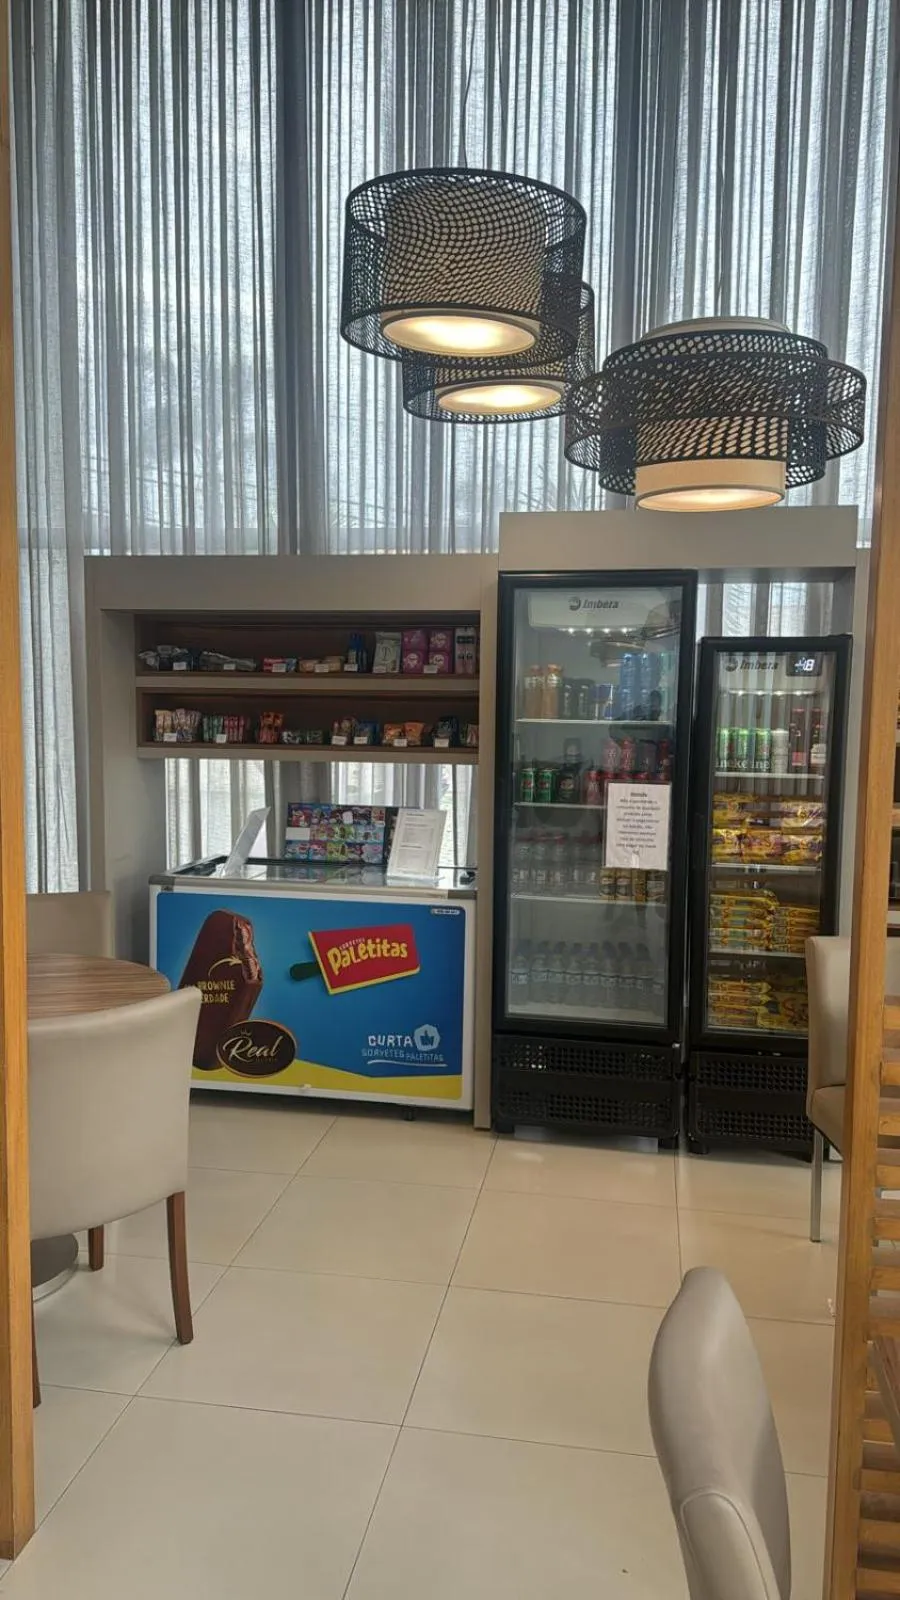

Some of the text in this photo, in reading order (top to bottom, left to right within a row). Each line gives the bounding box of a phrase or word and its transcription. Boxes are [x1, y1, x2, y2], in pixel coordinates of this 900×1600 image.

[201, 992, 230, 1004] ERDADE
[367, 1034, 414, 1048] CURTA
[222, 1034, 284, 1063] Real
